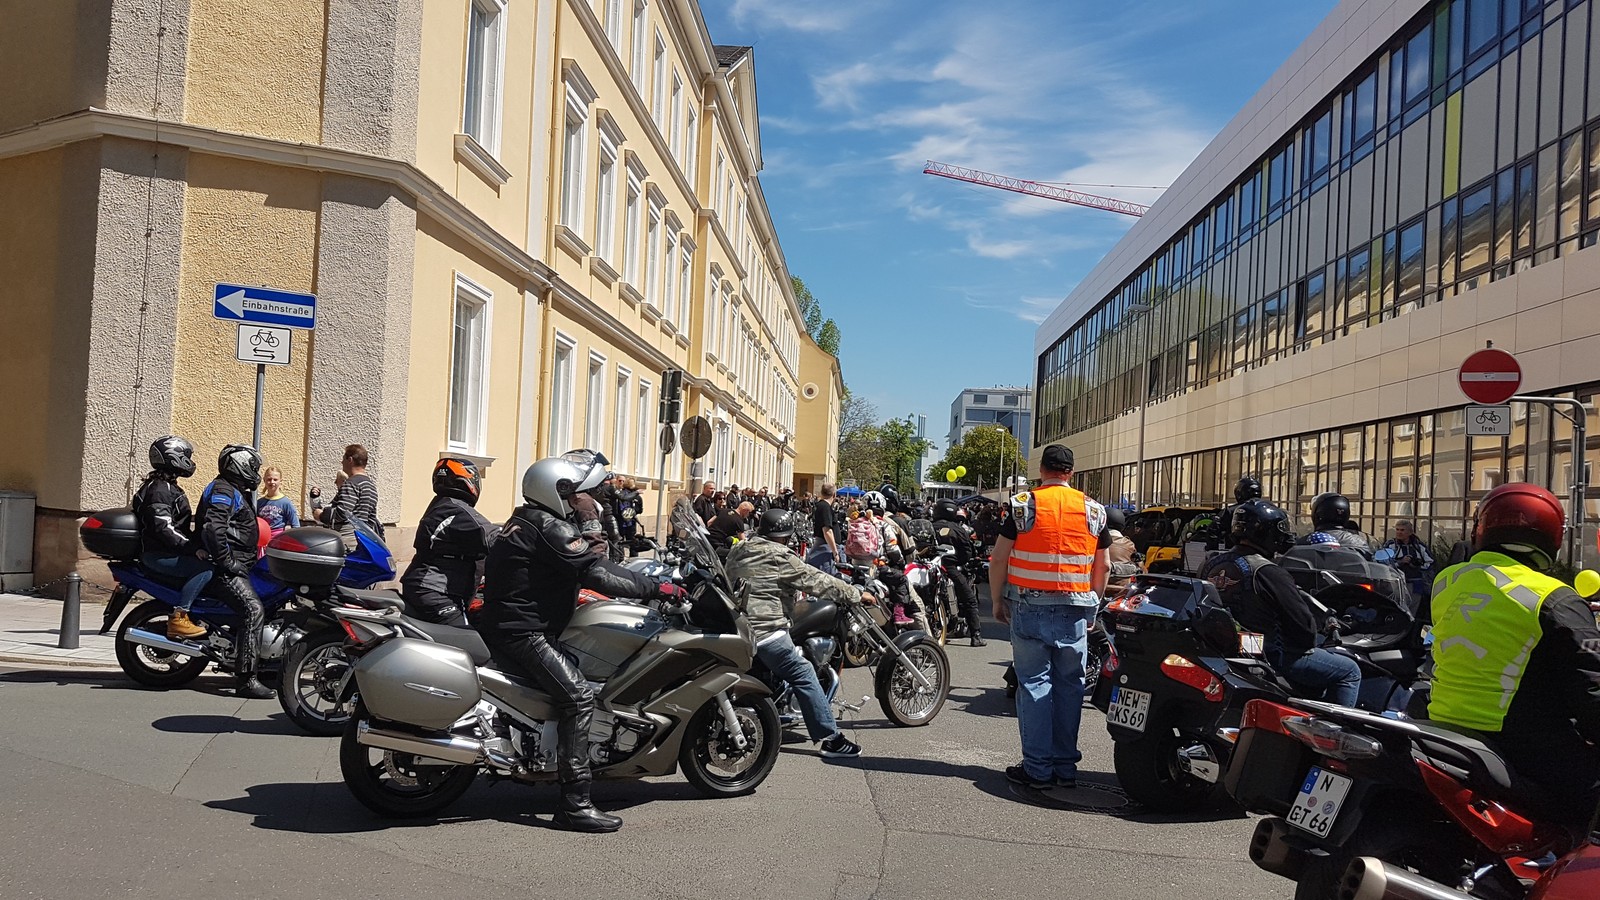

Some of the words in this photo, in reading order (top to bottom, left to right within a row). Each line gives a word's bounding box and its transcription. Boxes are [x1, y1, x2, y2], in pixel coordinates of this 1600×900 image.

[242, 300, 309, 315] Einbahnstraße
[1117, 690, 1140, 708] NEW
[1320, 775, 1335, 792] N
